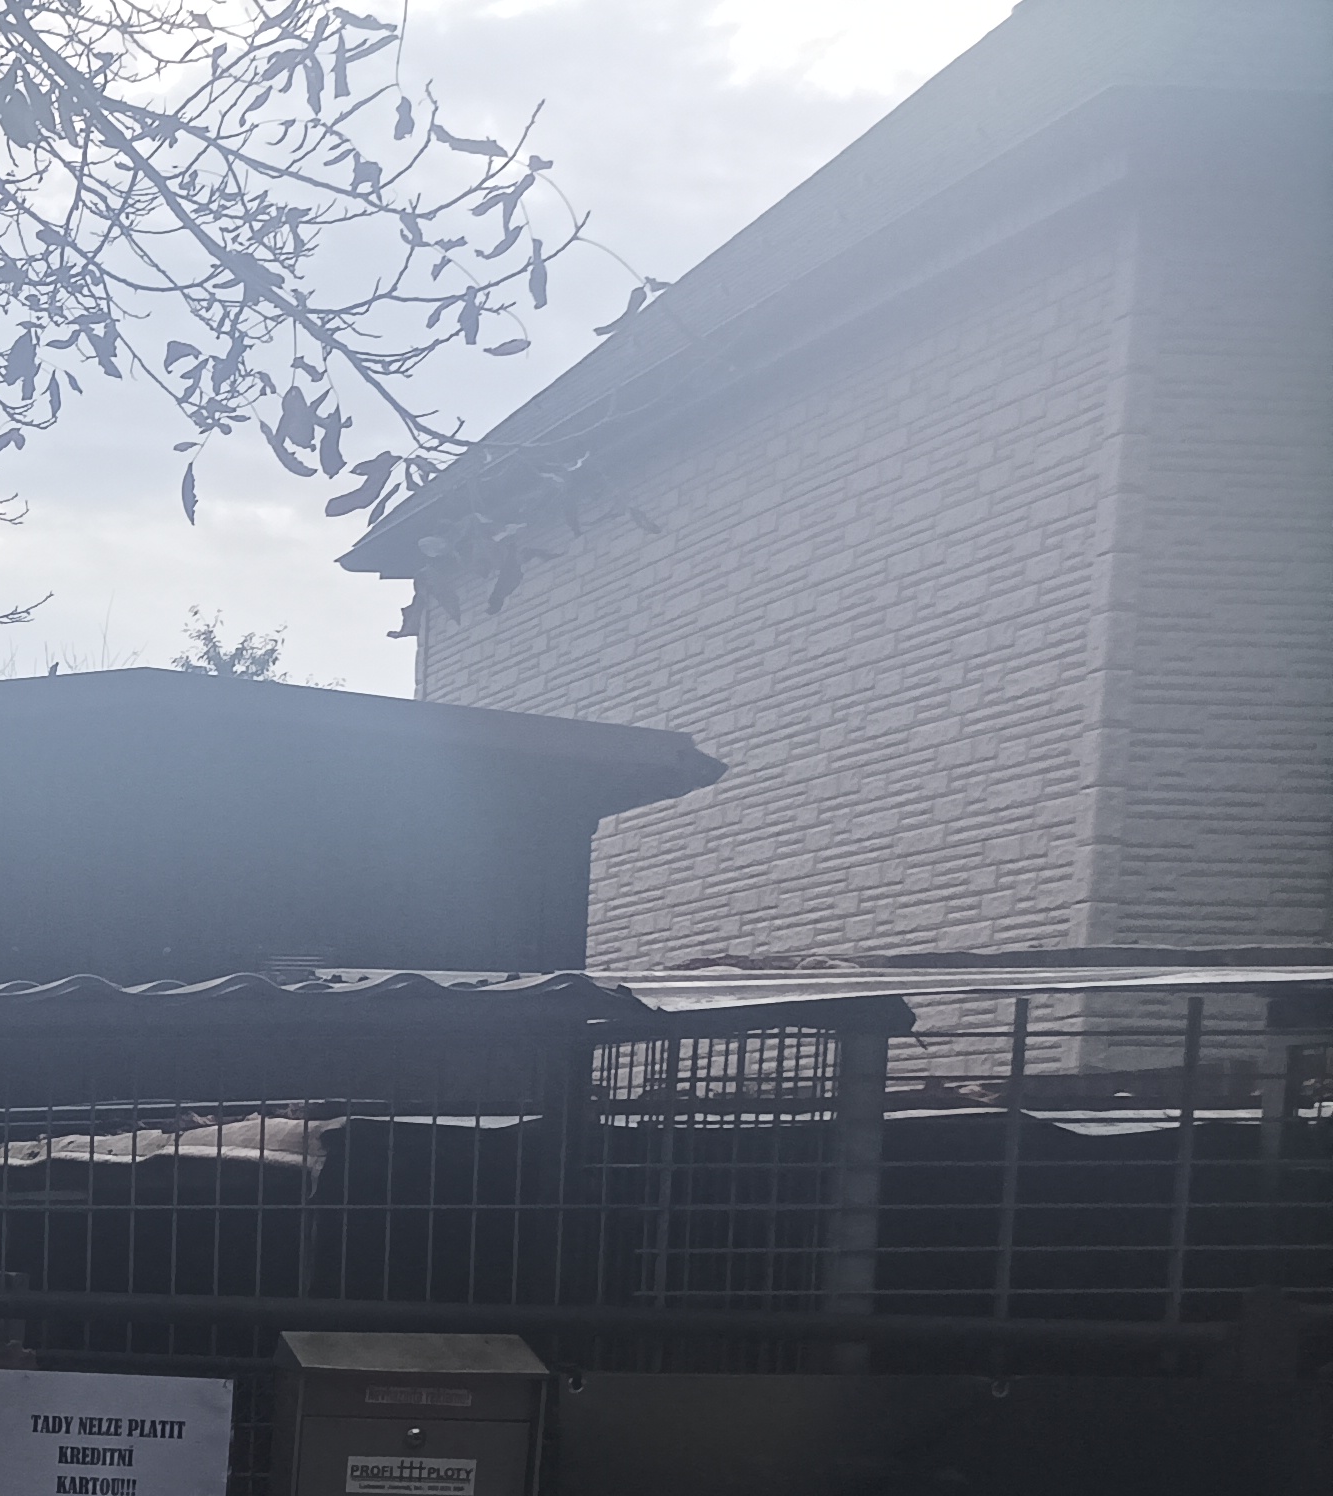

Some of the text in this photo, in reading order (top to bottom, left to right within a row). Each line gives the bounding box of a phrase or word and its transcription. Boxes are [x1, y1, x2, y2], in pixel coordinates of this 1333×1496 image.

[31, 1414, 186, 1439] TADY NELZE PLATIT
[58, 1444, 134, 1467] KREDITNÍ
[351, 1465, 473, 1480] PROFI PLOTY
[56, 1475, 137, 1496] KARTOU!!!
